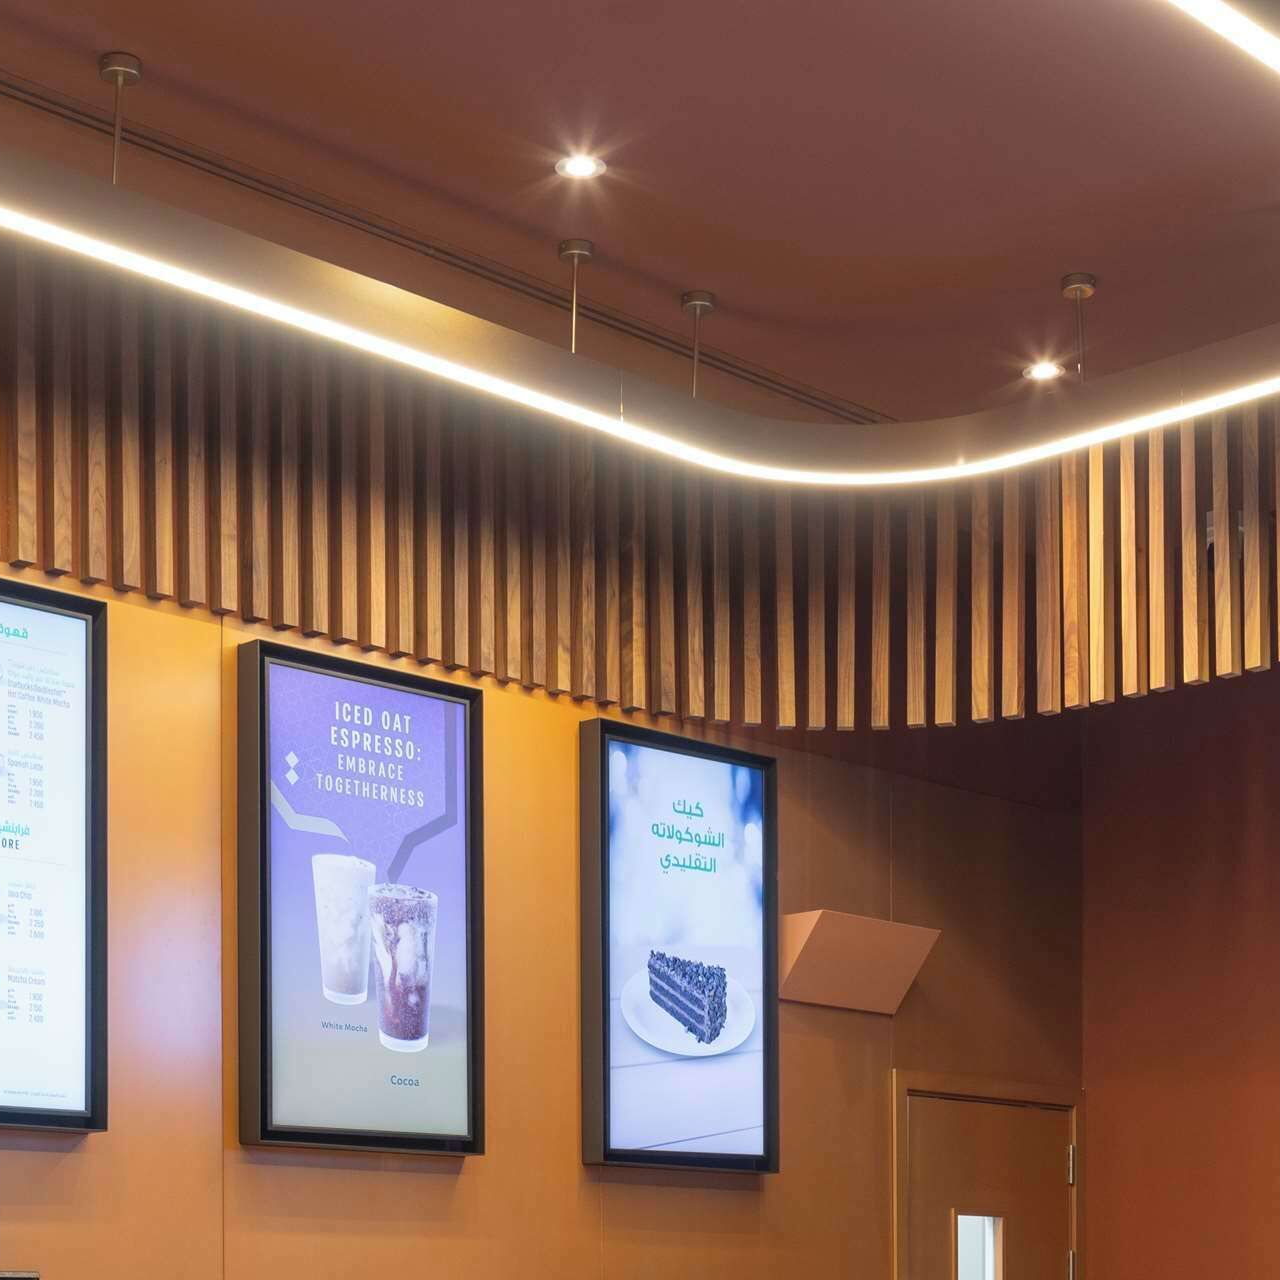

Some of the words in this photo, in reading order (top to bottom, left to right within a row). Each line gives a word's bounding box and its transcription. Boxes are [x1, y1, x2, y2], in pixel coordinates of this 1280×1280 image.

[335, 701, 372, 726] ICED
[381, 711, 412, 734] OAT
[330, 726, 421, 761] ESPRESSO:
[337, 754, 404, 780] EMBRACE
[316, 772, 425, 808] TOGETHERNESS
[672, 797, 704, 818] كيك
[651, 821, 726, 849] الشوكولاته
[659, 852, 717, 874] التقليدي
[321, 1020, 344, 1031] White
[345, 1023, 368, 1033] Mocha
[390, 1074, 420, 1087] Cocoa
